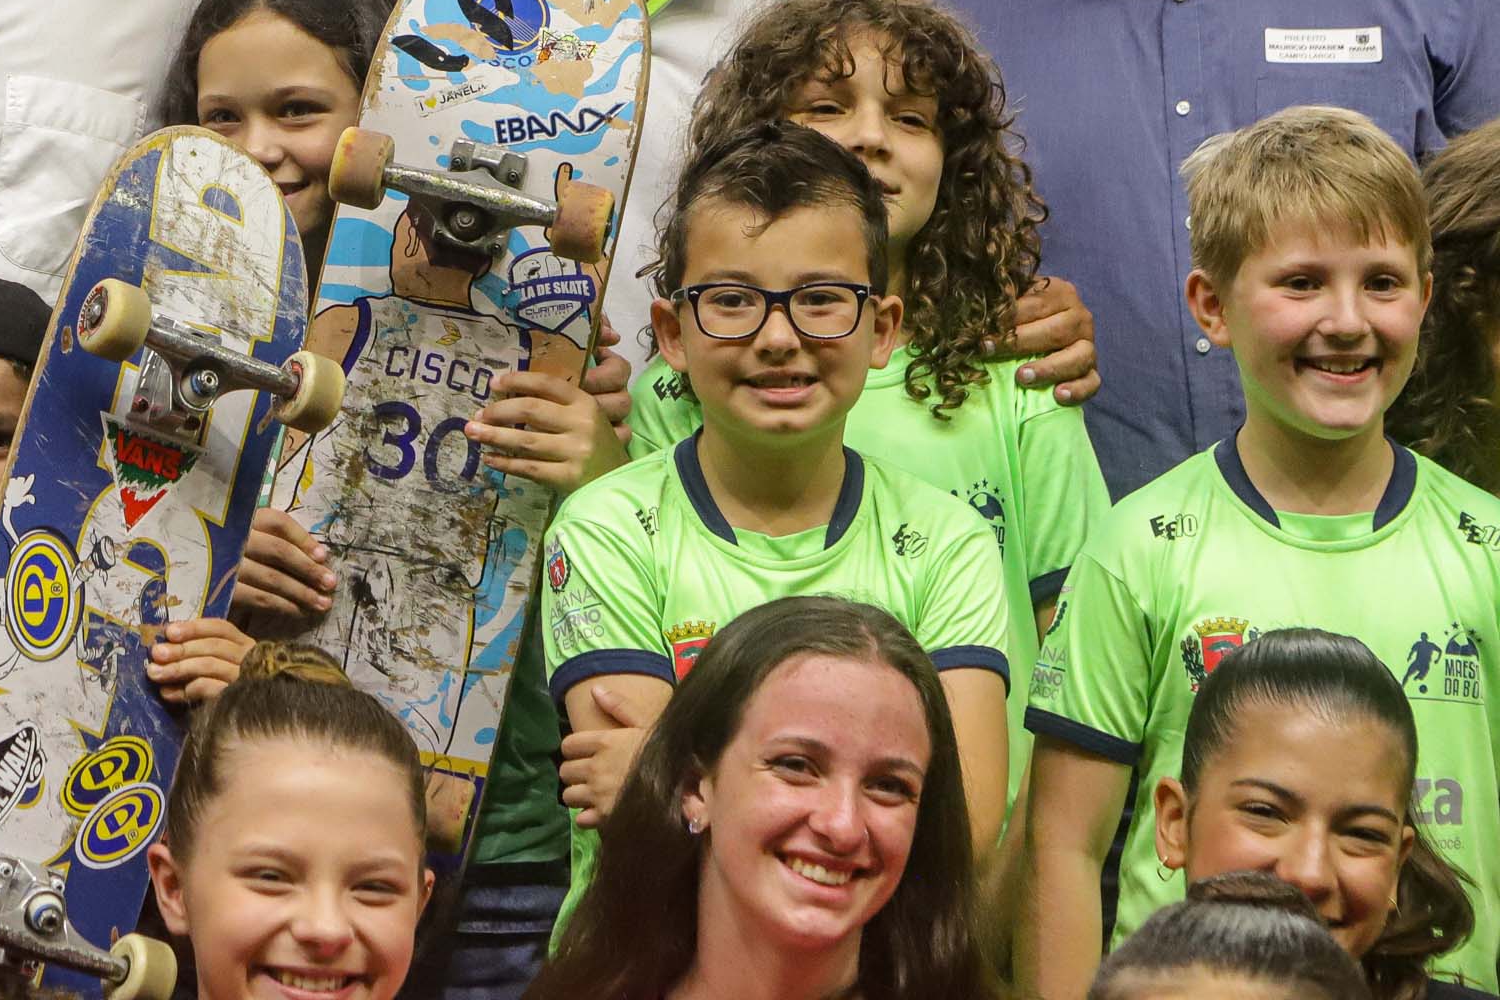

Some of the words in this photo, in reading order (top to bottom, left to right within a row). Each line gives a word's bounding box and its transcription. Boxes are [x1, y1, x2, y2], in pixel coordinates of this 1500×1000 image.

[495, 102, 626, 145] EBANX
[536, 283, 552, 296] DE
[552, 279, 591, 297] SKATE
[384, 346, 494, 401] CISCO
[116, 428, 186, 481] VANS
[363, 401, 482, 494] 30
[1444, 678, 1460, 697] DA
